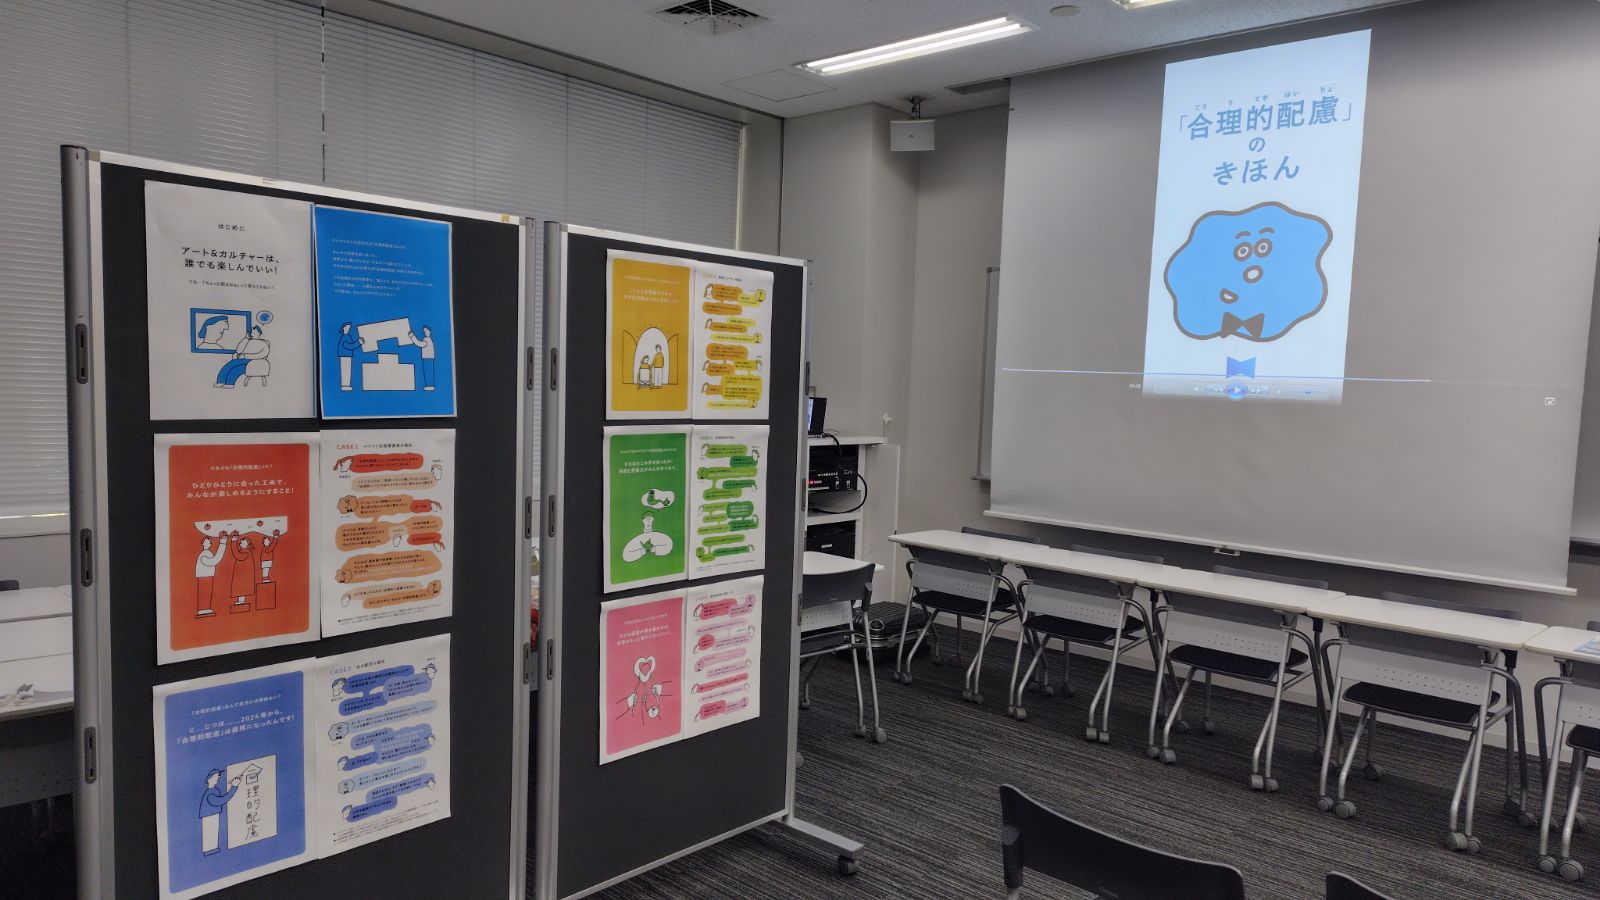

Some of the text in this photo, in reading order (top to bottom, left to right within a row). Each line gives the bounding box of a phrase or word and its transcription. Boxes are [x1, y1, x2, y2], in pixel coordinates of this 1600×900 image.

[1179, 95, 1353, 141] 「合理的配慮」
[1248, 136, 1266, 153] の
[1212, 155, 1300, 186] きほん
[217, 223, 246, 232] はじめに
